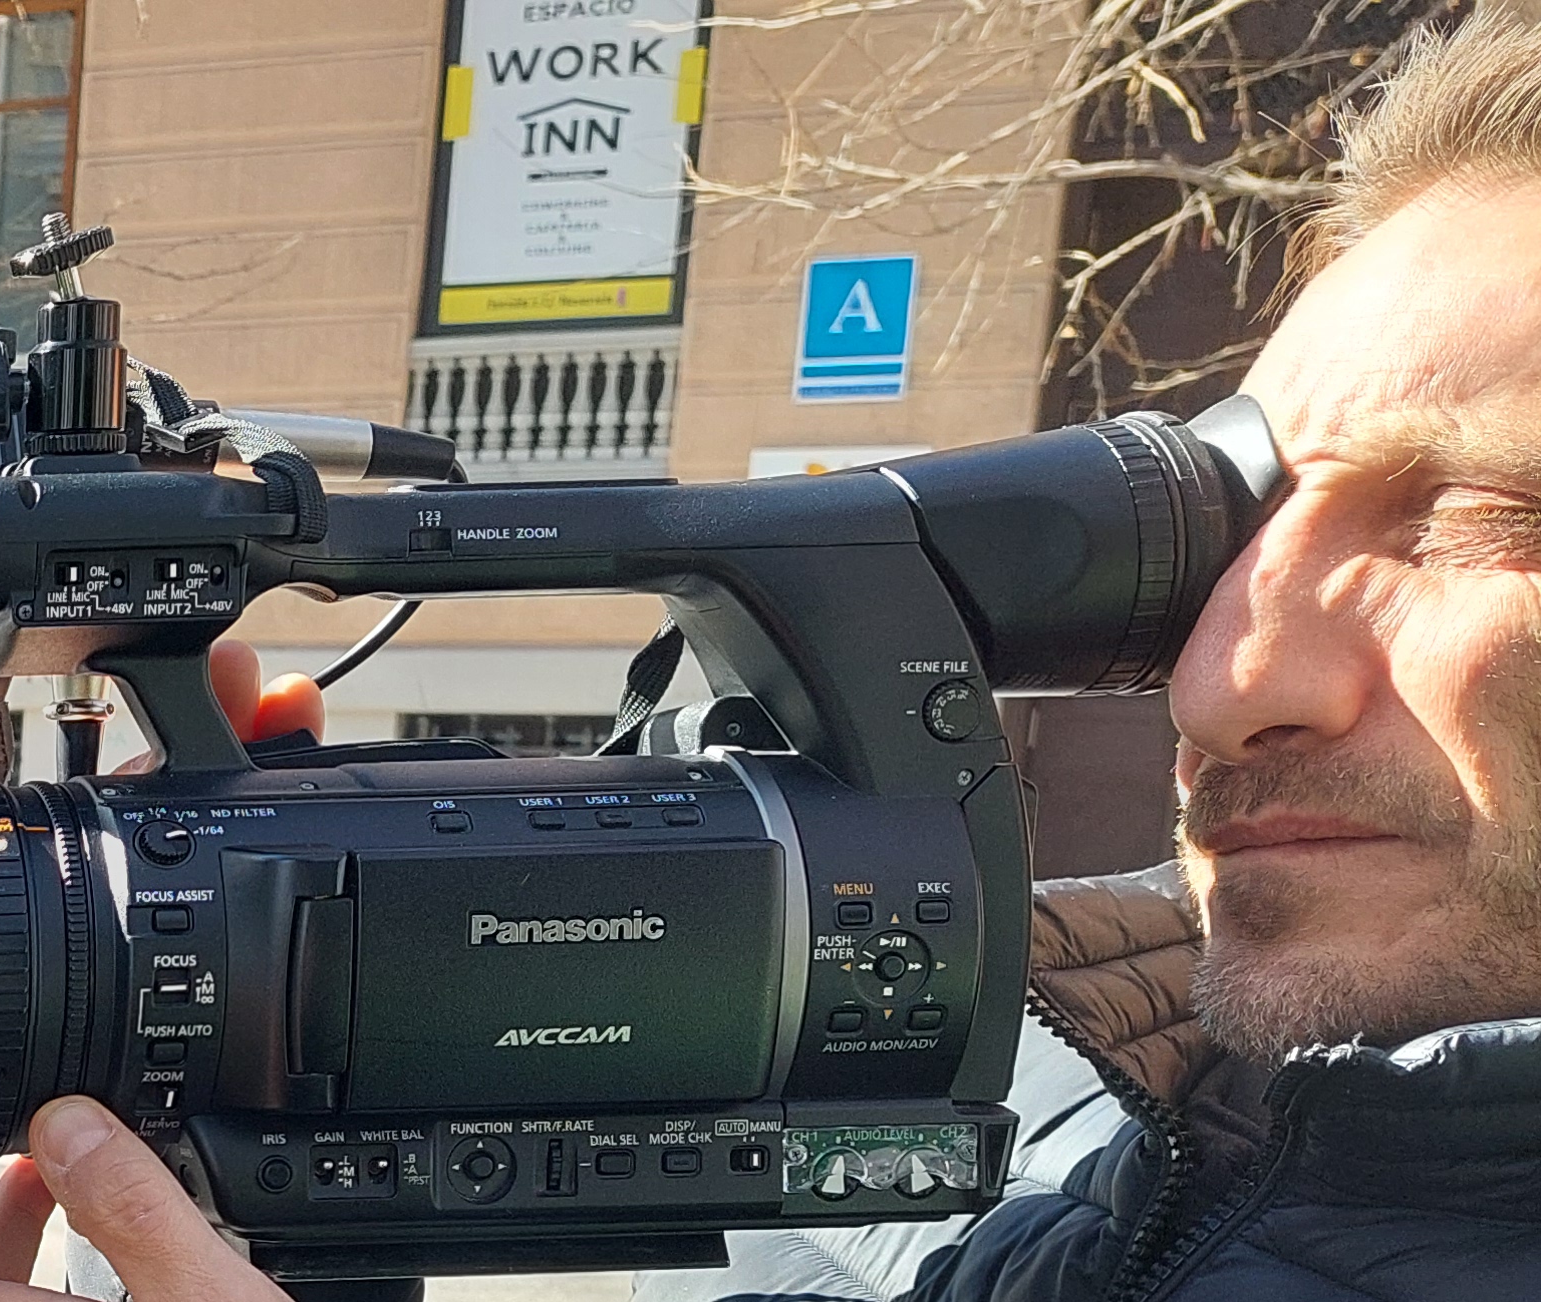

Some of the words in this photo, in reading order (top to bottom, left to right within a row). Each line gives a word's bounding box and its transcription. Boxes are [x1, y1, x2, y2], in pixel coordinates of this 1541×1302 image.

[523, 0, 635, 22] ESPACIO
[487, 38, 665, 85] WORK
[521, 117, 621, 157] INN
[828, 278, 883, 333] A
[457, 528, 510, 540] HANDLE
[516, 527, 558, 539] ZOOM
[89, 566, 105, 577] ON
[189, 563, 204, 574] ON
[87, 581, 104, 591] OFF
[186, 578, 204, 589] OFF
[47, 592, 67, 603] LINE
[72, 591, 90, 602] MIC
[146, 589, 167, 600] LINE
[171, 588, 190, 600] MIC
[900, 661, 940, 673] SCENE
[944, 661, 969, 673] FILE
[519, 797, 553, 807] USER
[556, 797, 563, 805] 1
[585, 796, 619, 805] USER
[621, 795, 631, 804] 2
[651, 794, 685, 802] USER
[686, 793, 696, 801] 3
[433, 800, 456, 809] OIS
[210, 809, 231, 818] ND
[235, 808, 277, 817] FILTER
[833, 883, 874, 895] MENU
[918, 882, 951, 894] EXEC
[135, 891, 174, 902] FOCUS
[176, 890, 215, 902] ASSIST
[471, 909, 665, 945] Panasonic
[814, 948, 855, 960] ENTER
[154, 955, 197, 967] FOCUS
[203, 971, 214, 982] A
[202, 983, 214, 994] M
[144, 1026, 175, 1037] PUSH
[177, 1024, 213, 1036] AUTO
[494, 1025, 632, 1047] AVCCAM
[822, 1041, 866, 1053] AUDIO
[869, 1038, 939, 1051] MON/ADV
[142, 1071, 184, 1082] ZOOM
[146, 1120, 180, 1129] SERVO
[450, 1122, 513, 1134] FUNCTION
[665, 1120, 696, 1132] DISP/
[718, 1122, 746, 1133] AUTO
[750, 1121, 782, 1132] MANU
[262, 1133, 286, 1145] IRIS
[314, 1132, 345, 1143] GAIN
[360, 1130, 399, 1142] WHITE
[401, 1129, 425, 1140] BAL
[590, 1135, 617, 1146] DIAL
[619, 1134, 639, 1146] SEL
[649, 1133, 685, 1144] MODE
[688, 1132, 713, 1143] CHK
[843, 1130, 881, 1141] AUDIO
[884, 1129, 916, 1140] LEVEL
[344, 1156, 350, 1165] L
[408, 1154, 416, 1163] B
[343, 1167, 355, 1176] M
[407, 1165, 418, 1174] A
[344, 1178, 352, 1188] H
